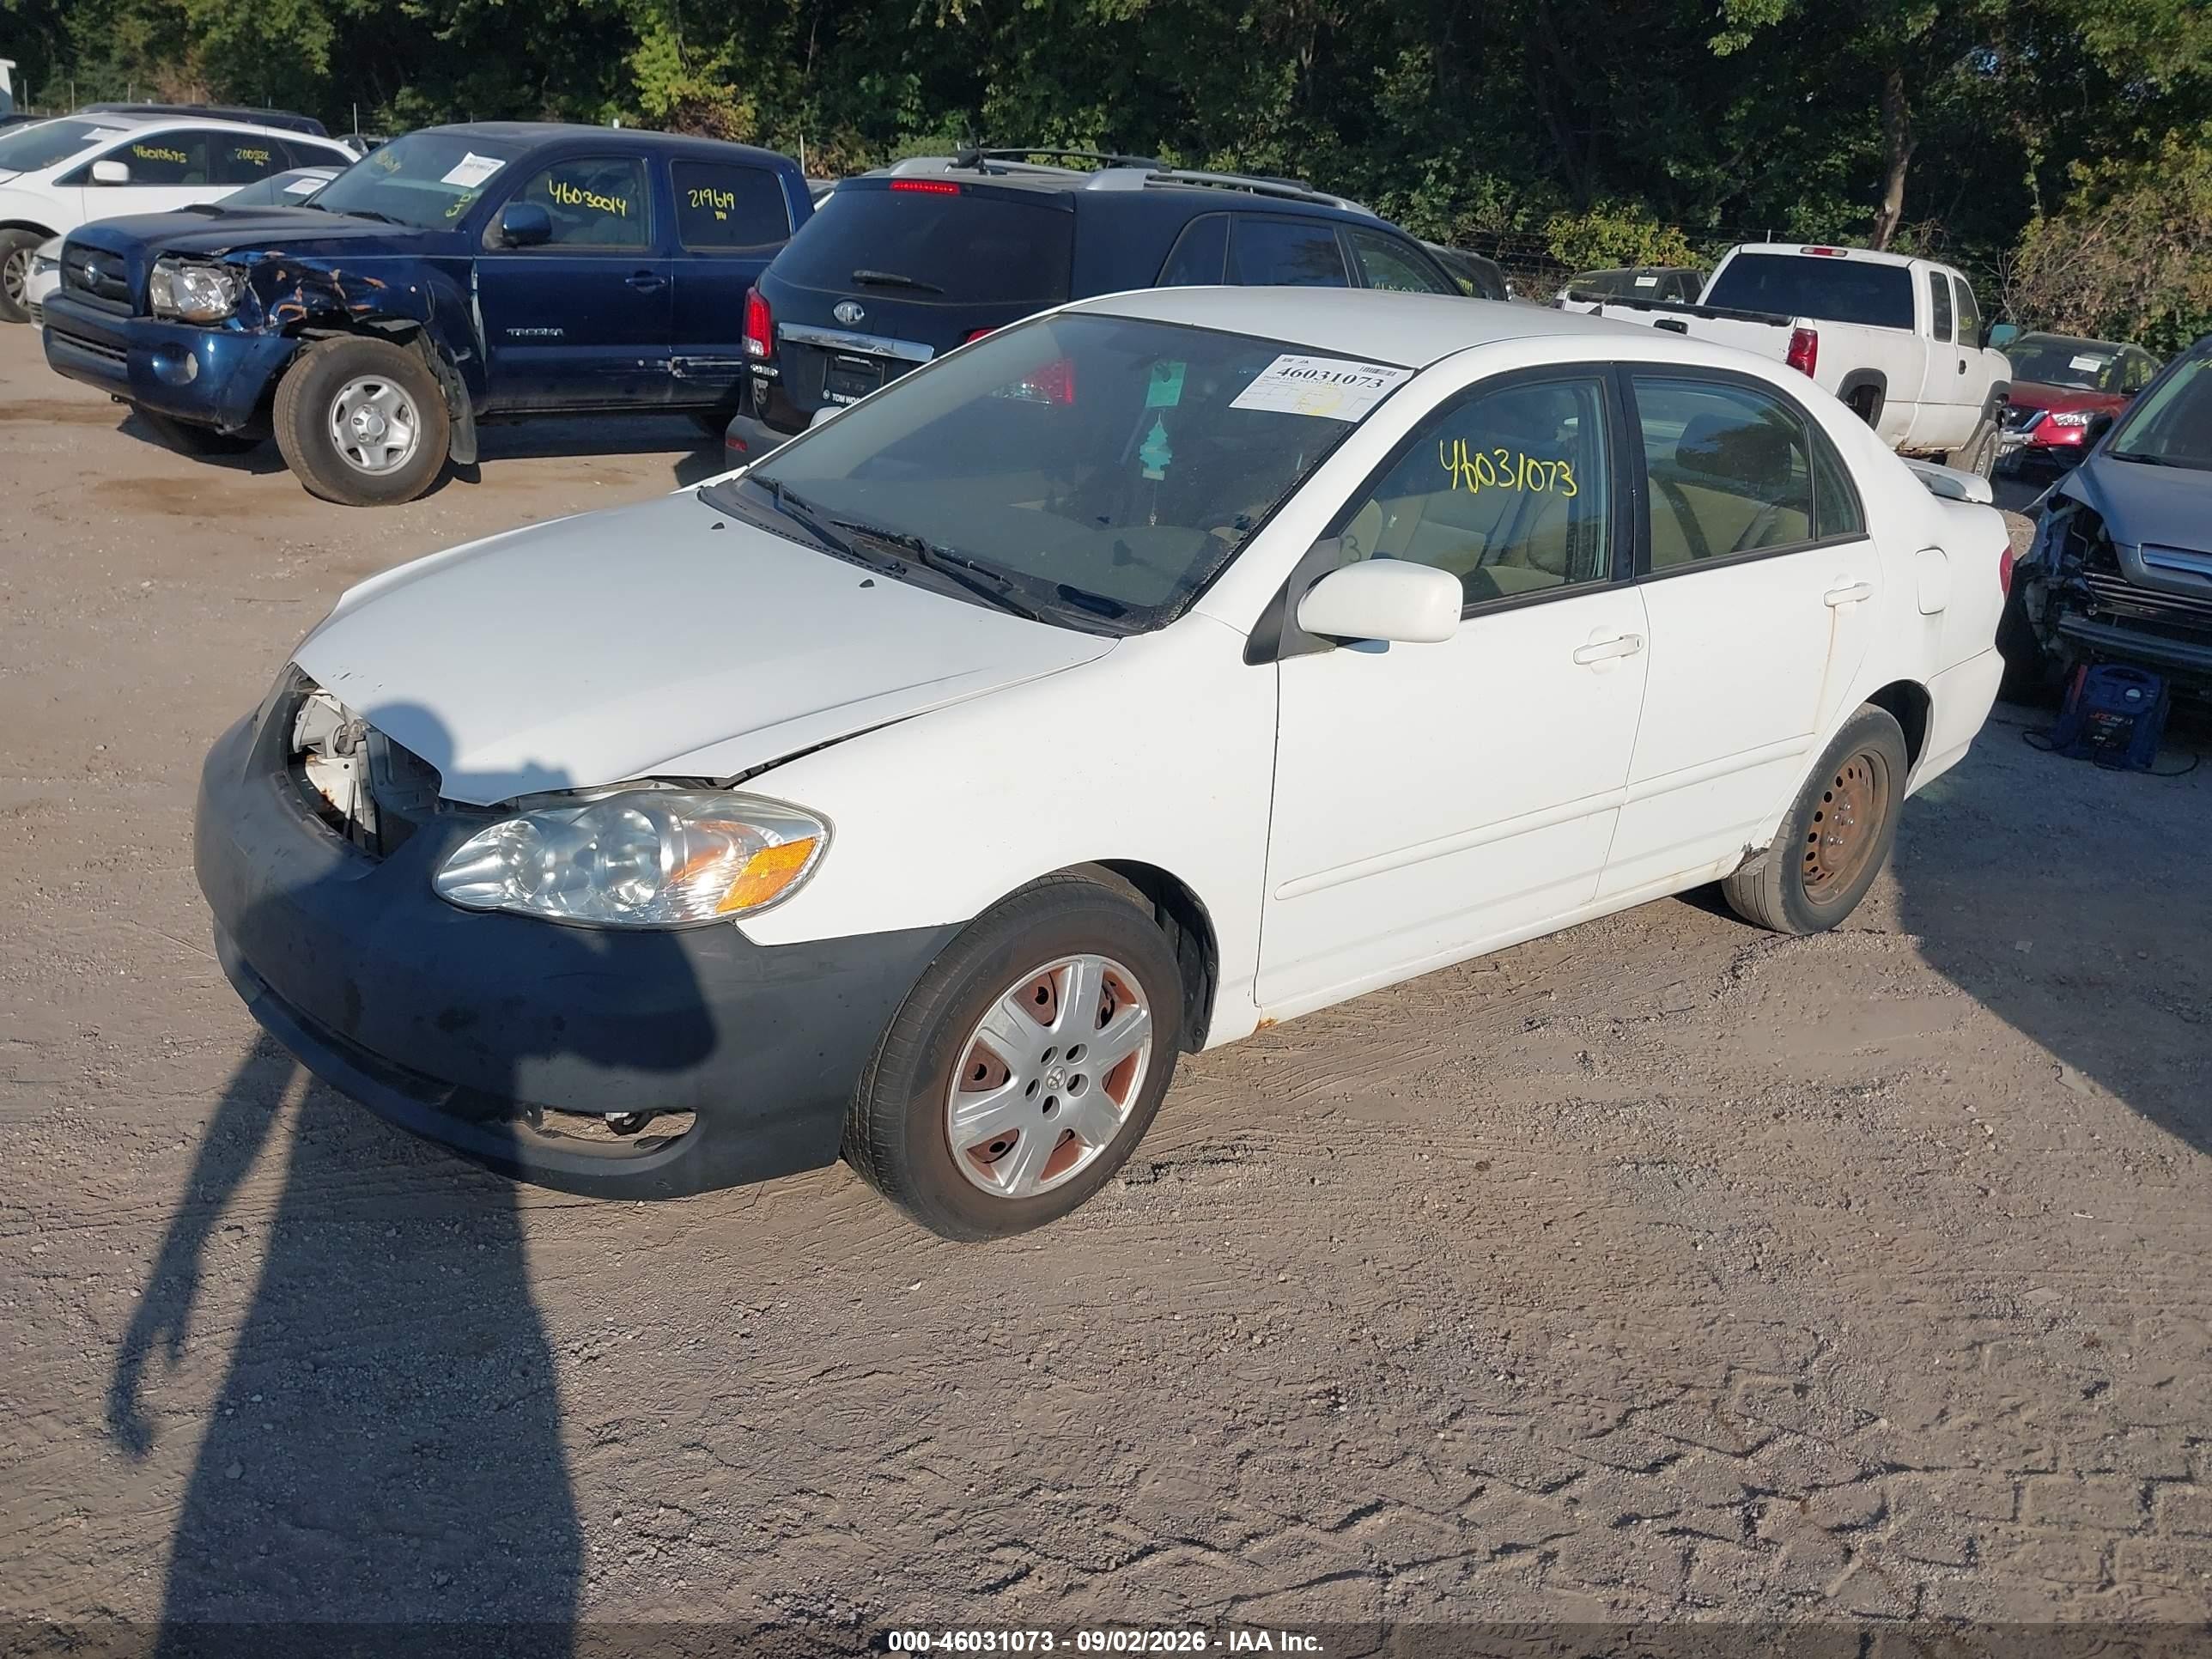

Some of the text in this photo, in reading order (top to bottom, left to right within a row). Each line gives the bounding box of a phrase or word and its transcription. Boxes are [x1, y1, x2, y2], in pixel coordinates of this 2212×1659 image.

[549, 179, 627, 216] 46030014
[688, 189, 735, 210] 219619
[1276, 367, 1385, 389] 46031073
[1439, 438, 1577, 497] 46031073
